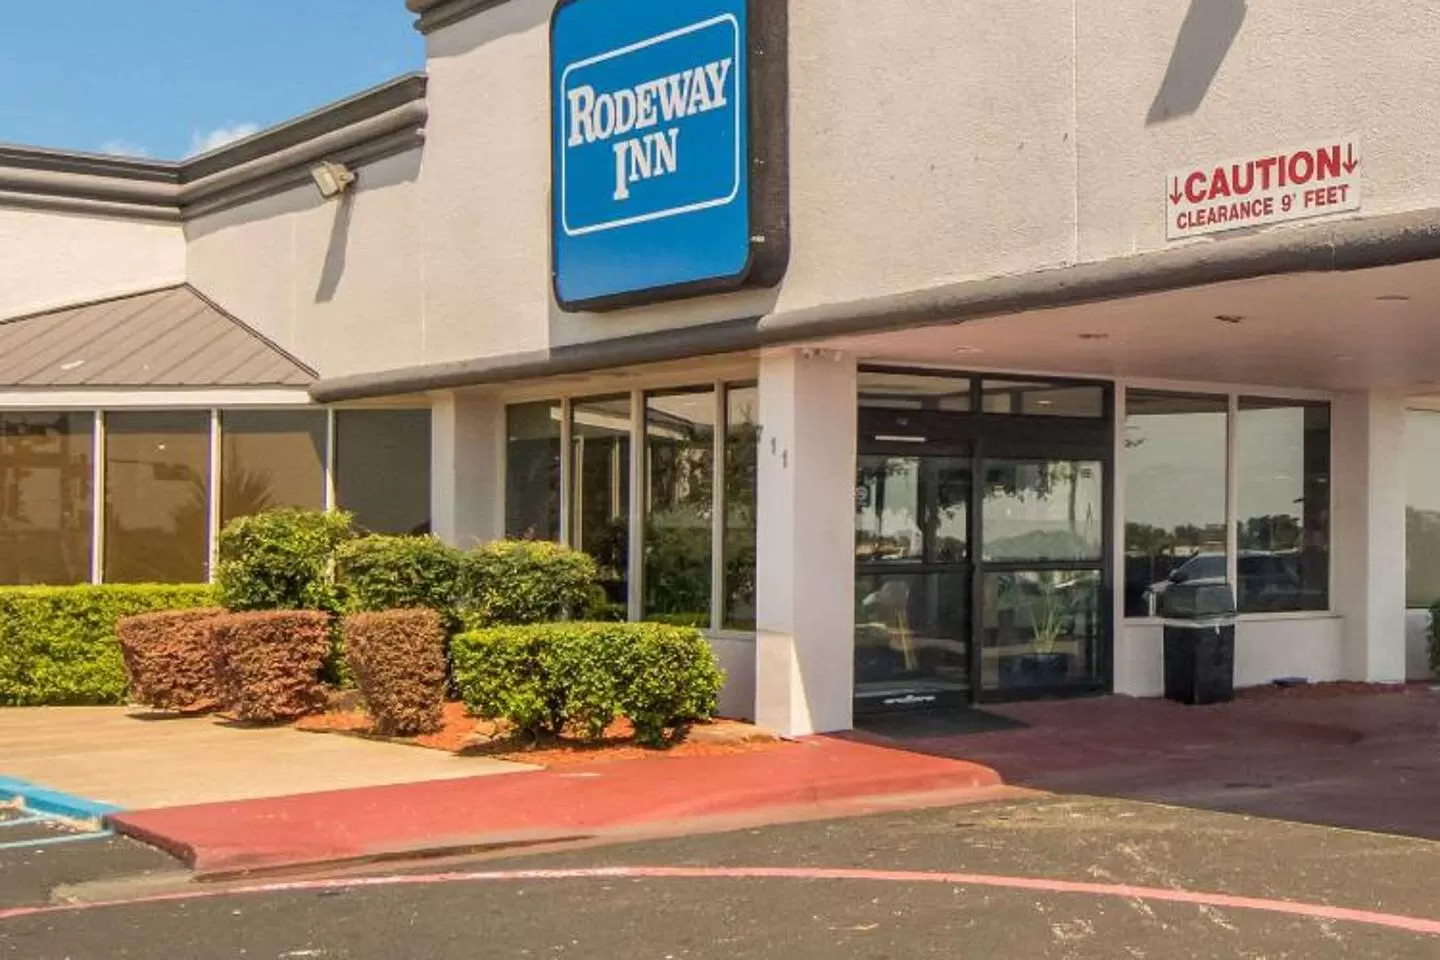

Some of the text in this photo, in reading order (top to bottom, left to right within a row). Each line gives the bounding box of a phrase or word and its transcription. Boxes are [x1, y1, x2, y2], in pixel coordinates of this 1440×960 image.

[567, 57, 732, 148] RODEWAY
[612, 127, 679, 200] INN
[1184, 145, 1341, 204] CAUTION
[1176, 197, 1274, 230] CLEARANCE
[1304, 184, 1349, 208] FEET
